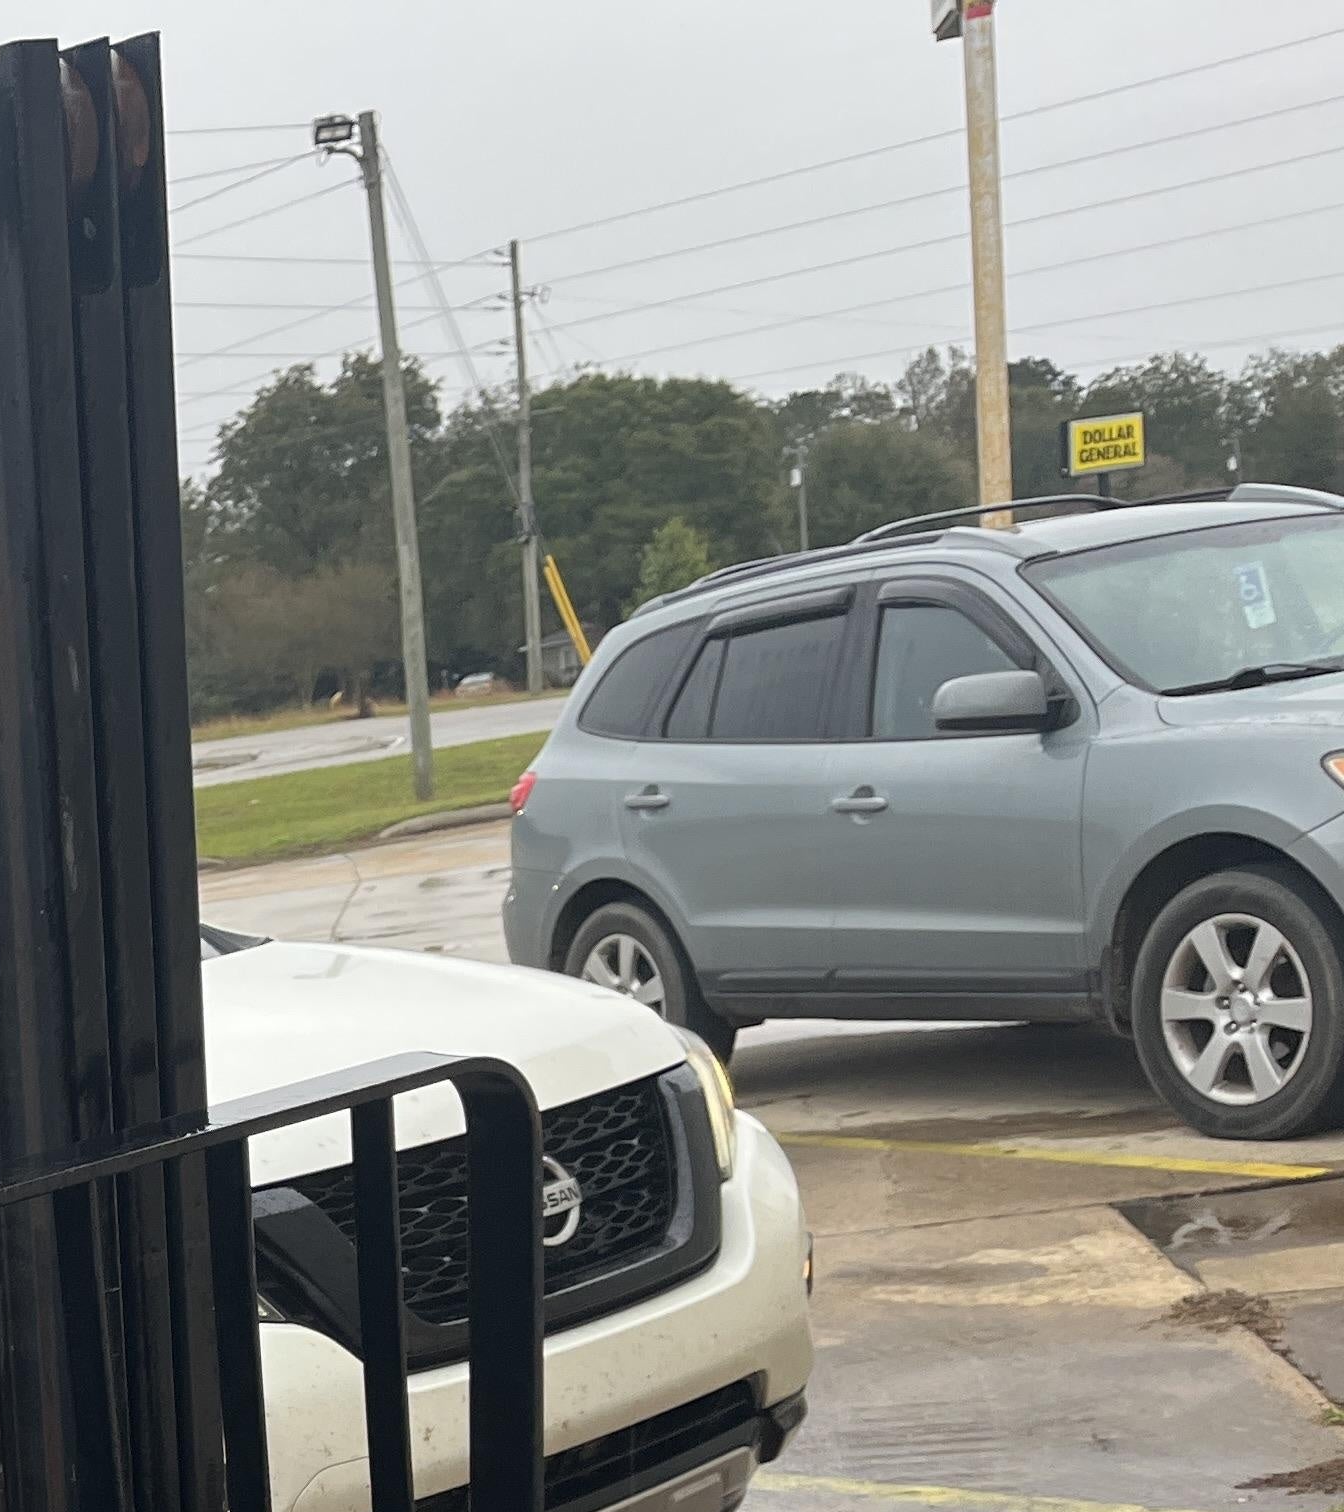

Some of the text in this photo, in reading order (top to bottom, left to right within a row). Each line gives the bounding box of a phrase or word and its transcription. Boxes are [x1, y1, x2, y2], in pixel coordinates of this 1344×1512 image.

[1082, 424, 1135, 446] DOLLAR
[1078, 441, 1140, 463] GENERAL
[543, 1184, 580, 1210] SAN
